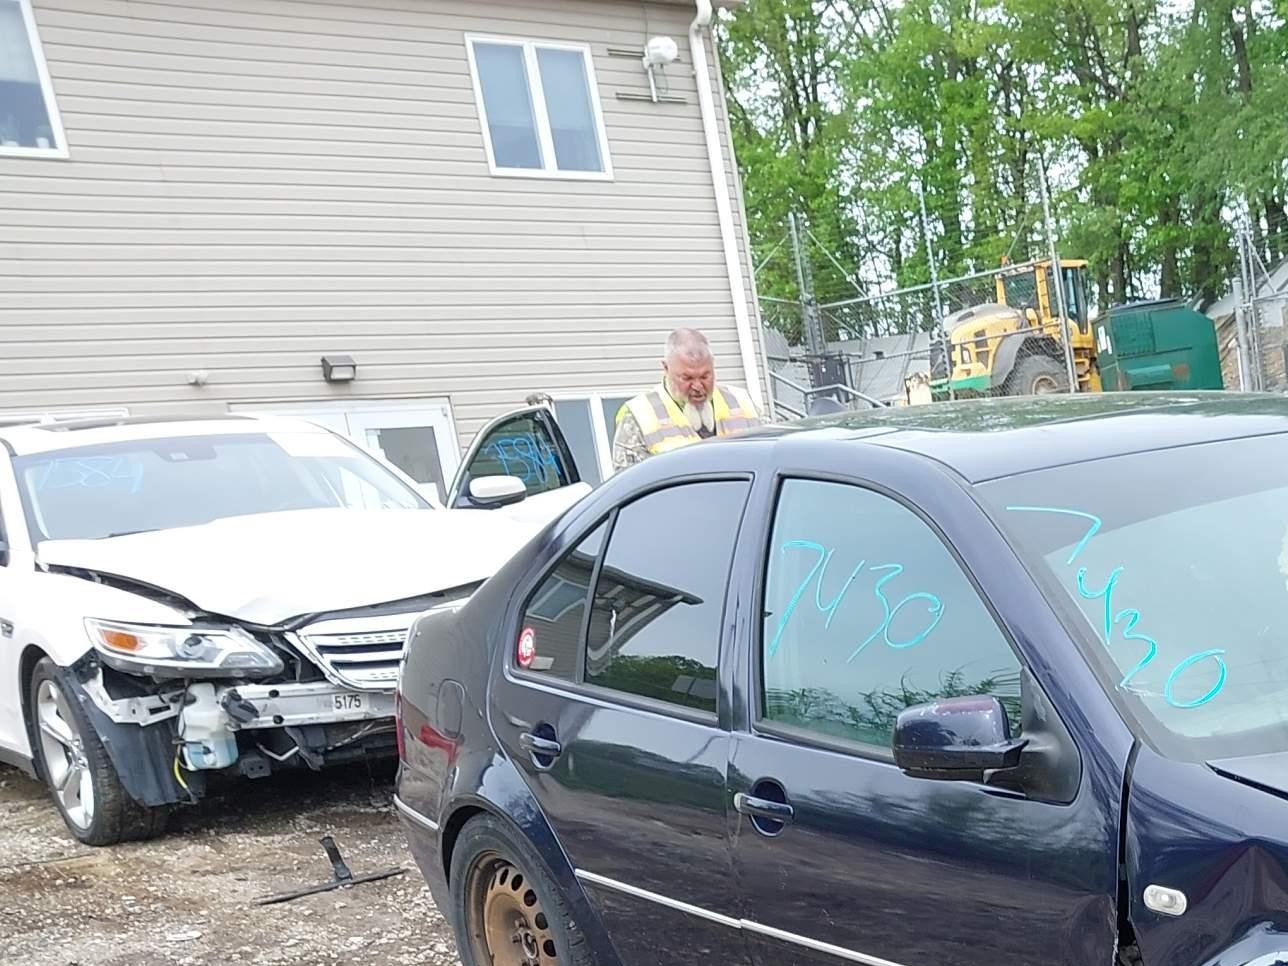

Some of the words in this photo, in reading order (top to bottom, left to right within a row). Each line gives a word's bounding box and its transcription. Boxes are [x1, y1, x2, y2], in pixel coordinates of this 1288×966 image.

[769, 540, 945, 664] 7430
[1006, 506, 1226, 709] 7430
[334, 693, 362, 710] 5175
